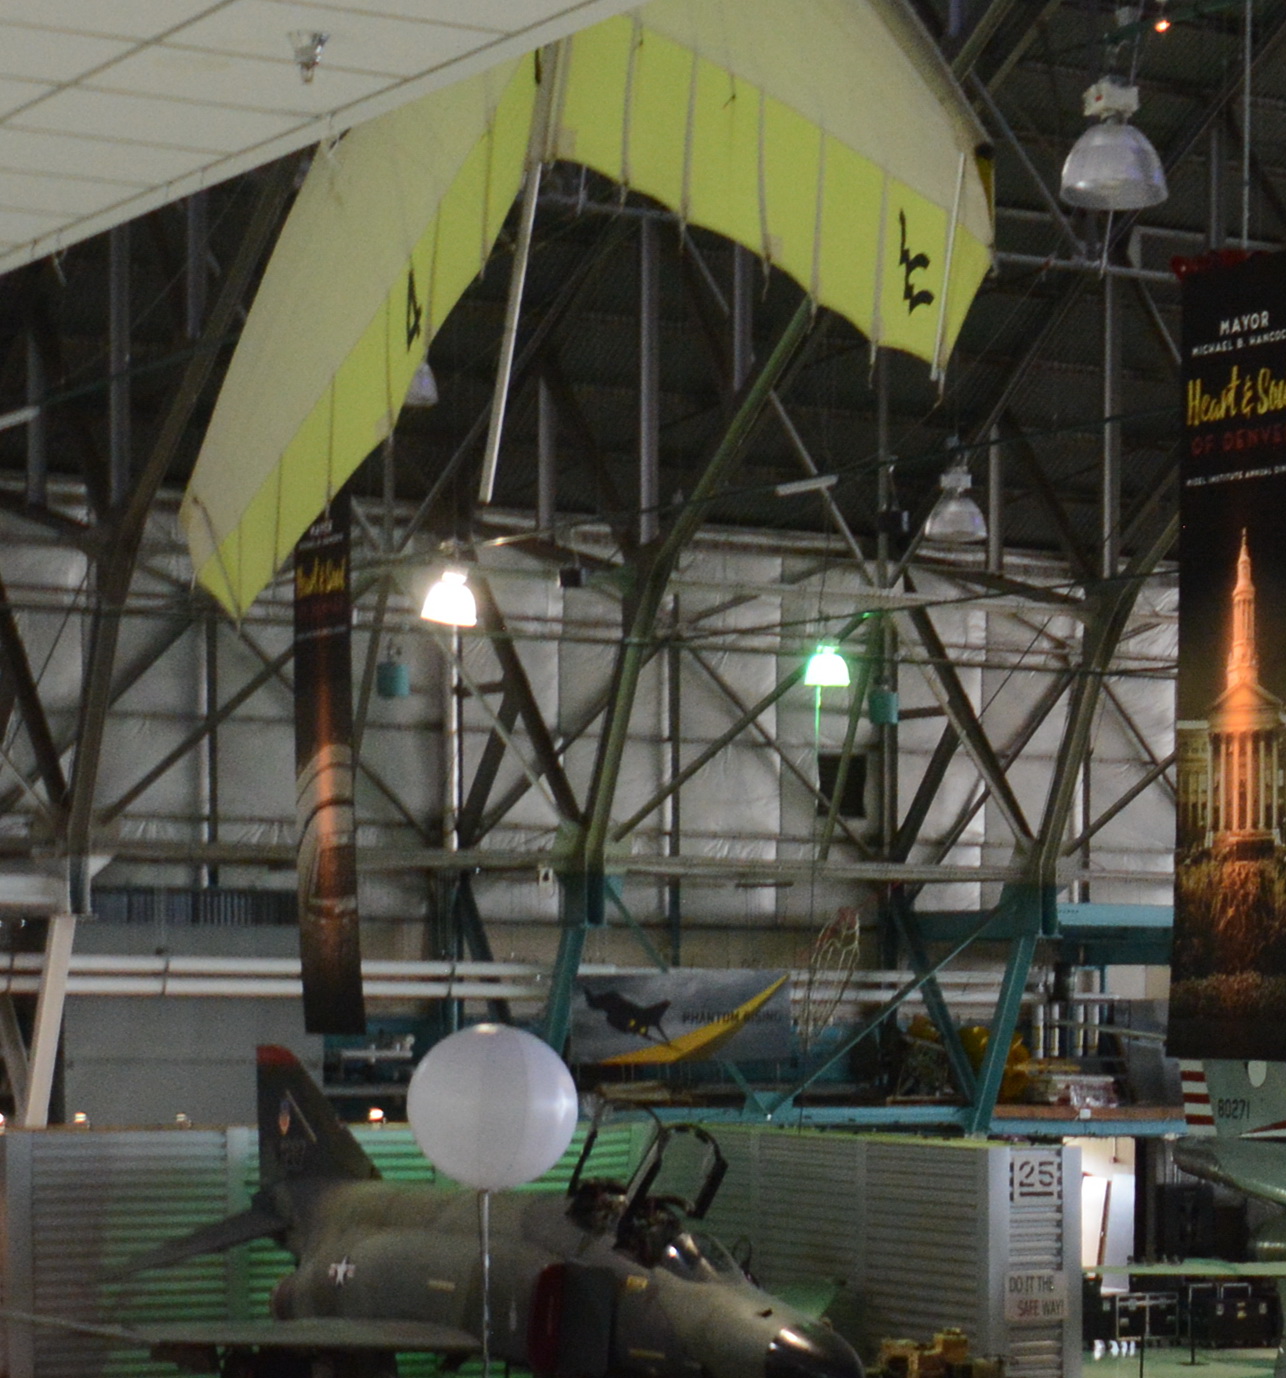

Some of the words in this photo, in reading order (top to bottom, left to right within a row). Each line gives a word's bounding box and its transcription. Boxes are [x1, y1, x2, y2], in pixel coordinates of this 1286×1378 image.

[1219, 310, 1270, 336] MAYOR
[1191, 339, 1234, 357] MICHAEL
[1186, 364, 1241, 427] Heart
[1241, 374, 1255, 418] &
[1009, 1277, 1023, 1293] DO
[1025, 1276, 1035, 1293] IT
[1037, 1275, 1054, 1292] THE
[1017, 1300, 1040, 1317] SAFE
